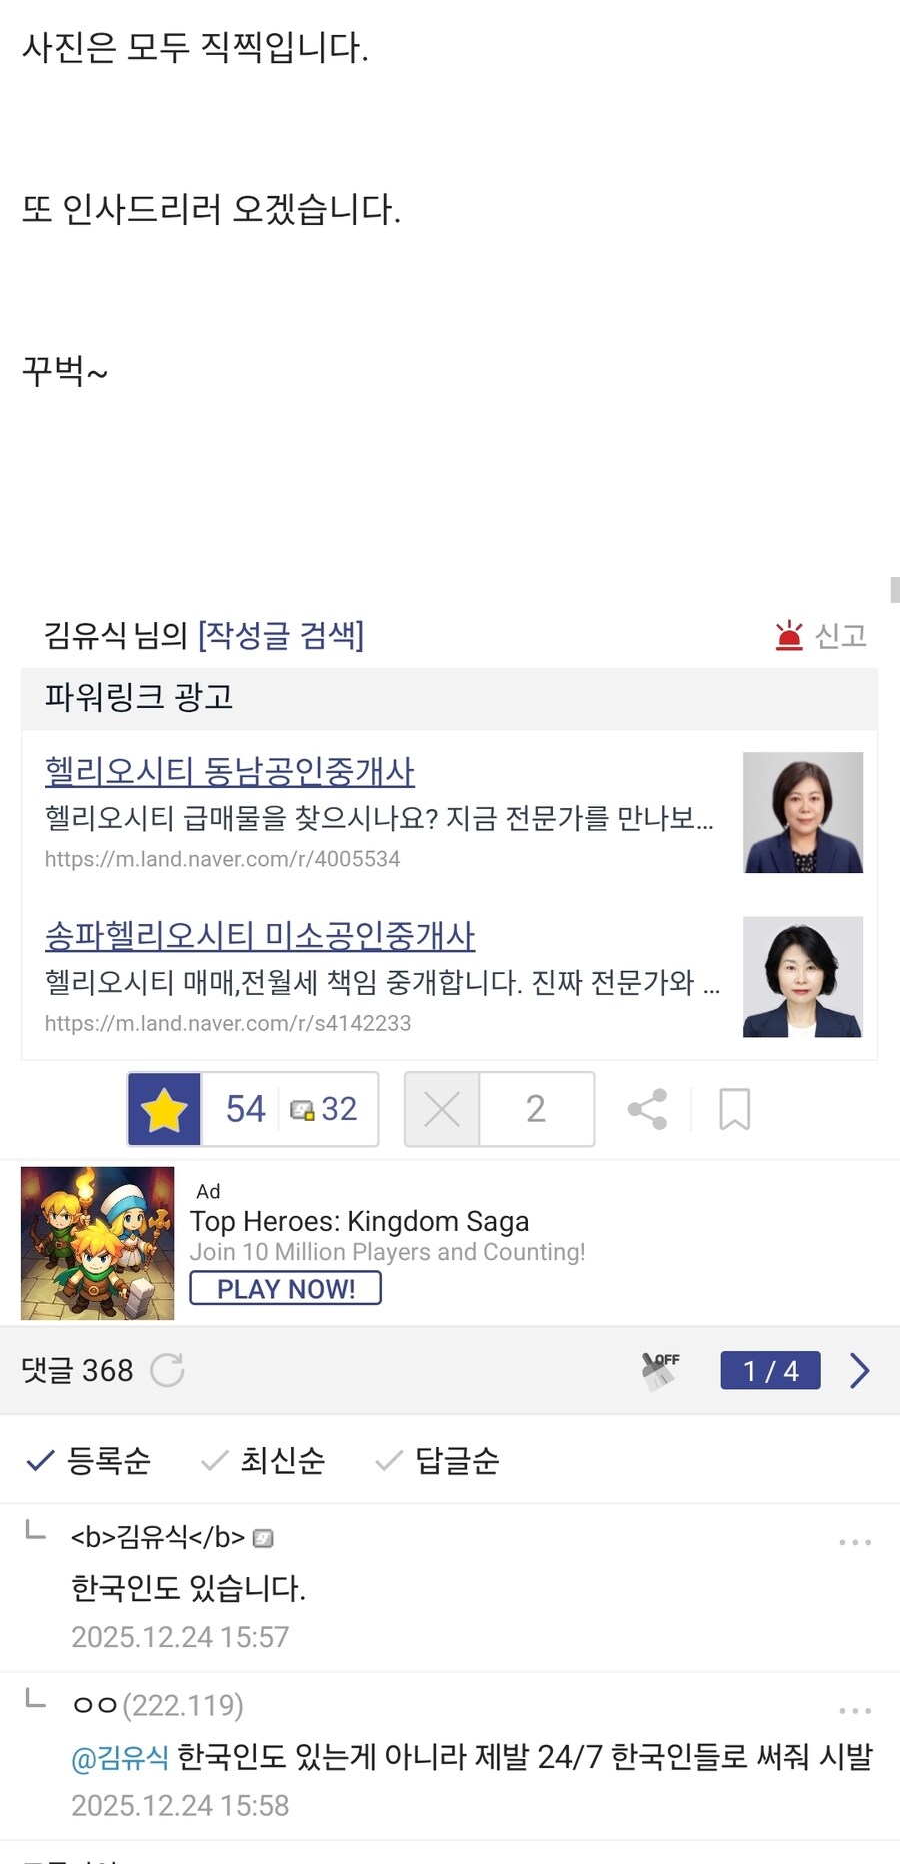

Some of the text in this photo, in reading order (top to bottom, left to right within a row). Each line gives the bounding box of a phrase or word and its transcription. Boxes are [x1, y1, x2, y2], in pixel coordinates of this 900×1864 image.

[22, 31, 367, 64] 사진은 모두 직찍입니다.
[22, 355, 107, 387] 꾸벅~
[45, 622, 186, 650] 김유식 님의
[200, 620, 363, 652] [작성글 검색]
[816, 623, 866, 649] 신고
[46, 756, 414, 784] 헬리오시티 동남공인중개사
[46, 850, 400, 871] https://m.land.naver.com/r/4005534
[227, 1095, 266, 1122] 54
[322, 1096, 357, 1121] 32
[190, 1209, 529, 1237] Top Heroes: Kingdom Saga
[218, 1279, 354, 1299] PLAY NOW!
[22, 1357, 133, 1384] 댓글 368
[744, 1360, 799, 1383] 1 / 4
[68, 1447, 151, 1476] 등록순
[241, 1447, 325, 1475] 최신순
[417, 1447, 499, 1475] 답글순
[71, 1525, 245, 1550] <b>김유식</b>
[72, 1574, 305, 1603] 한국인도 있습니다.
